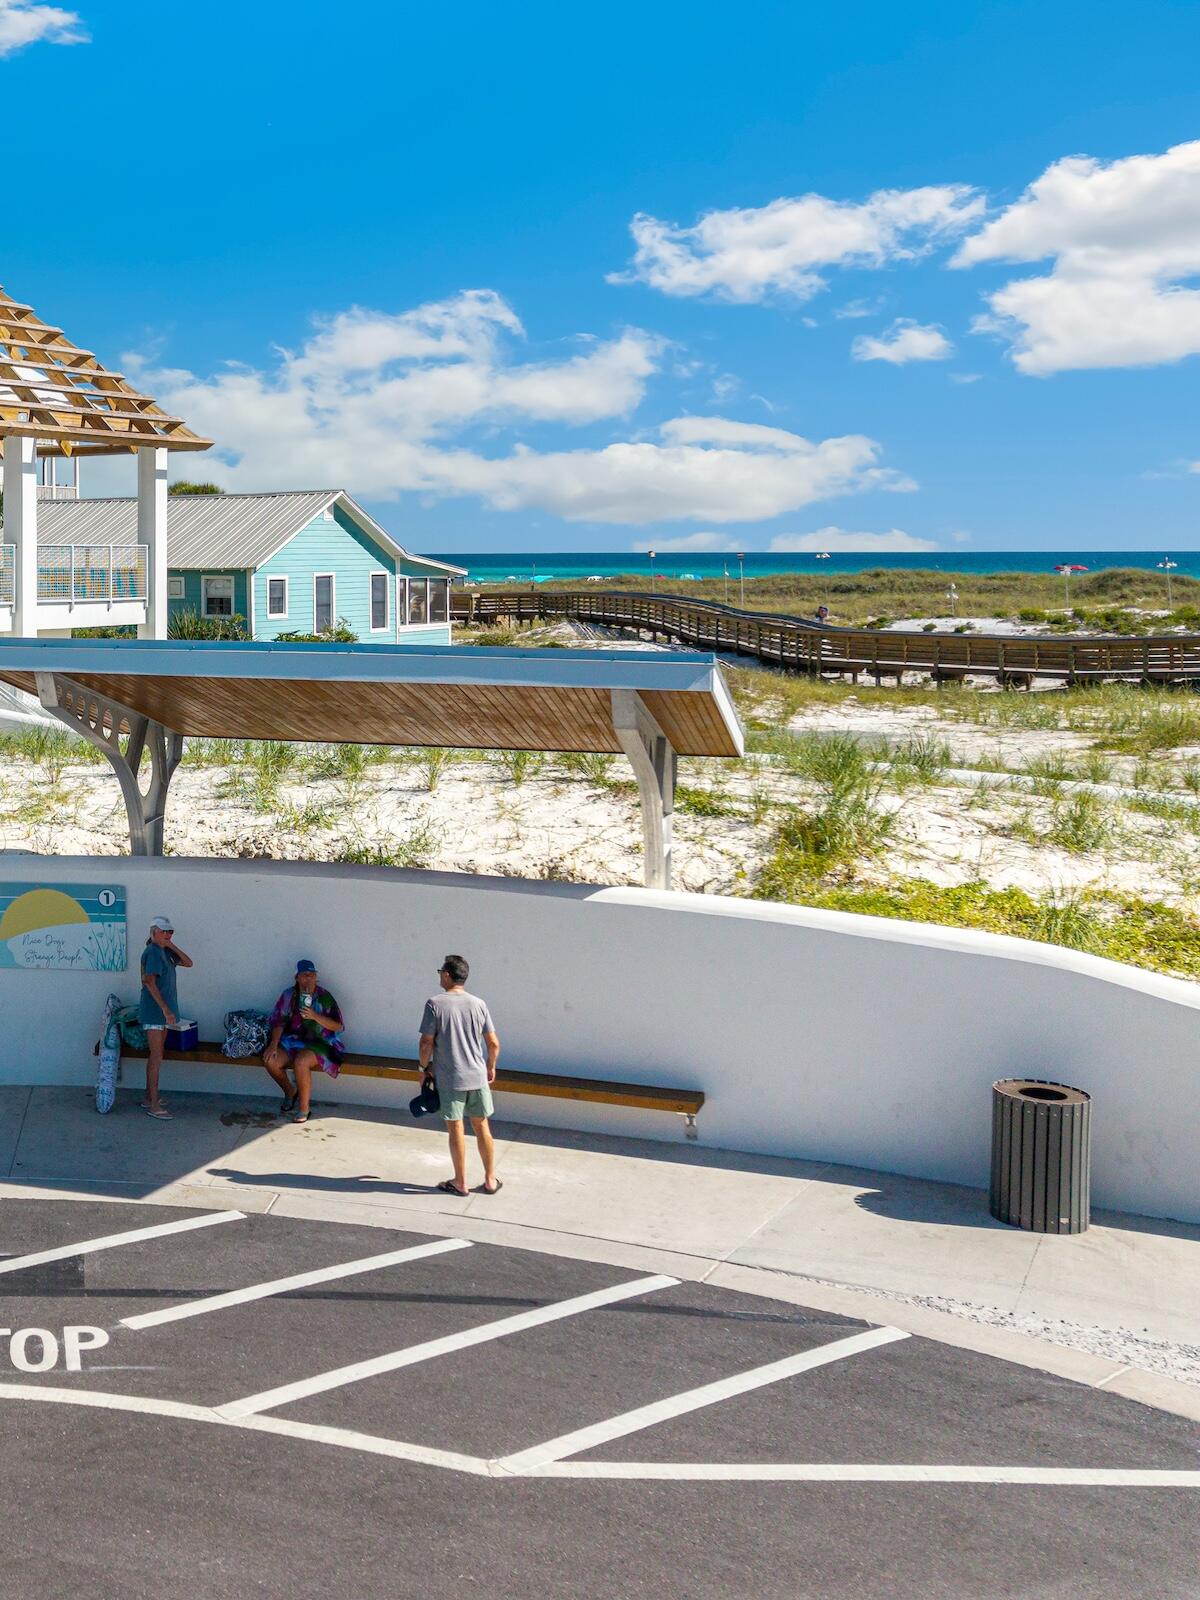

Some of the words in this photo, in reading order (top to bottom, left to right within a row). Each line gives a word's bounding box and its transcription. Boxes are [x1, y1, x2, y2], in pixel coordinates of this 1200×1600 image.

[103, 892, 110, 905] 1
[22, 934, 41, 945] Nice
[45, 934, 65, 951] Dogs
